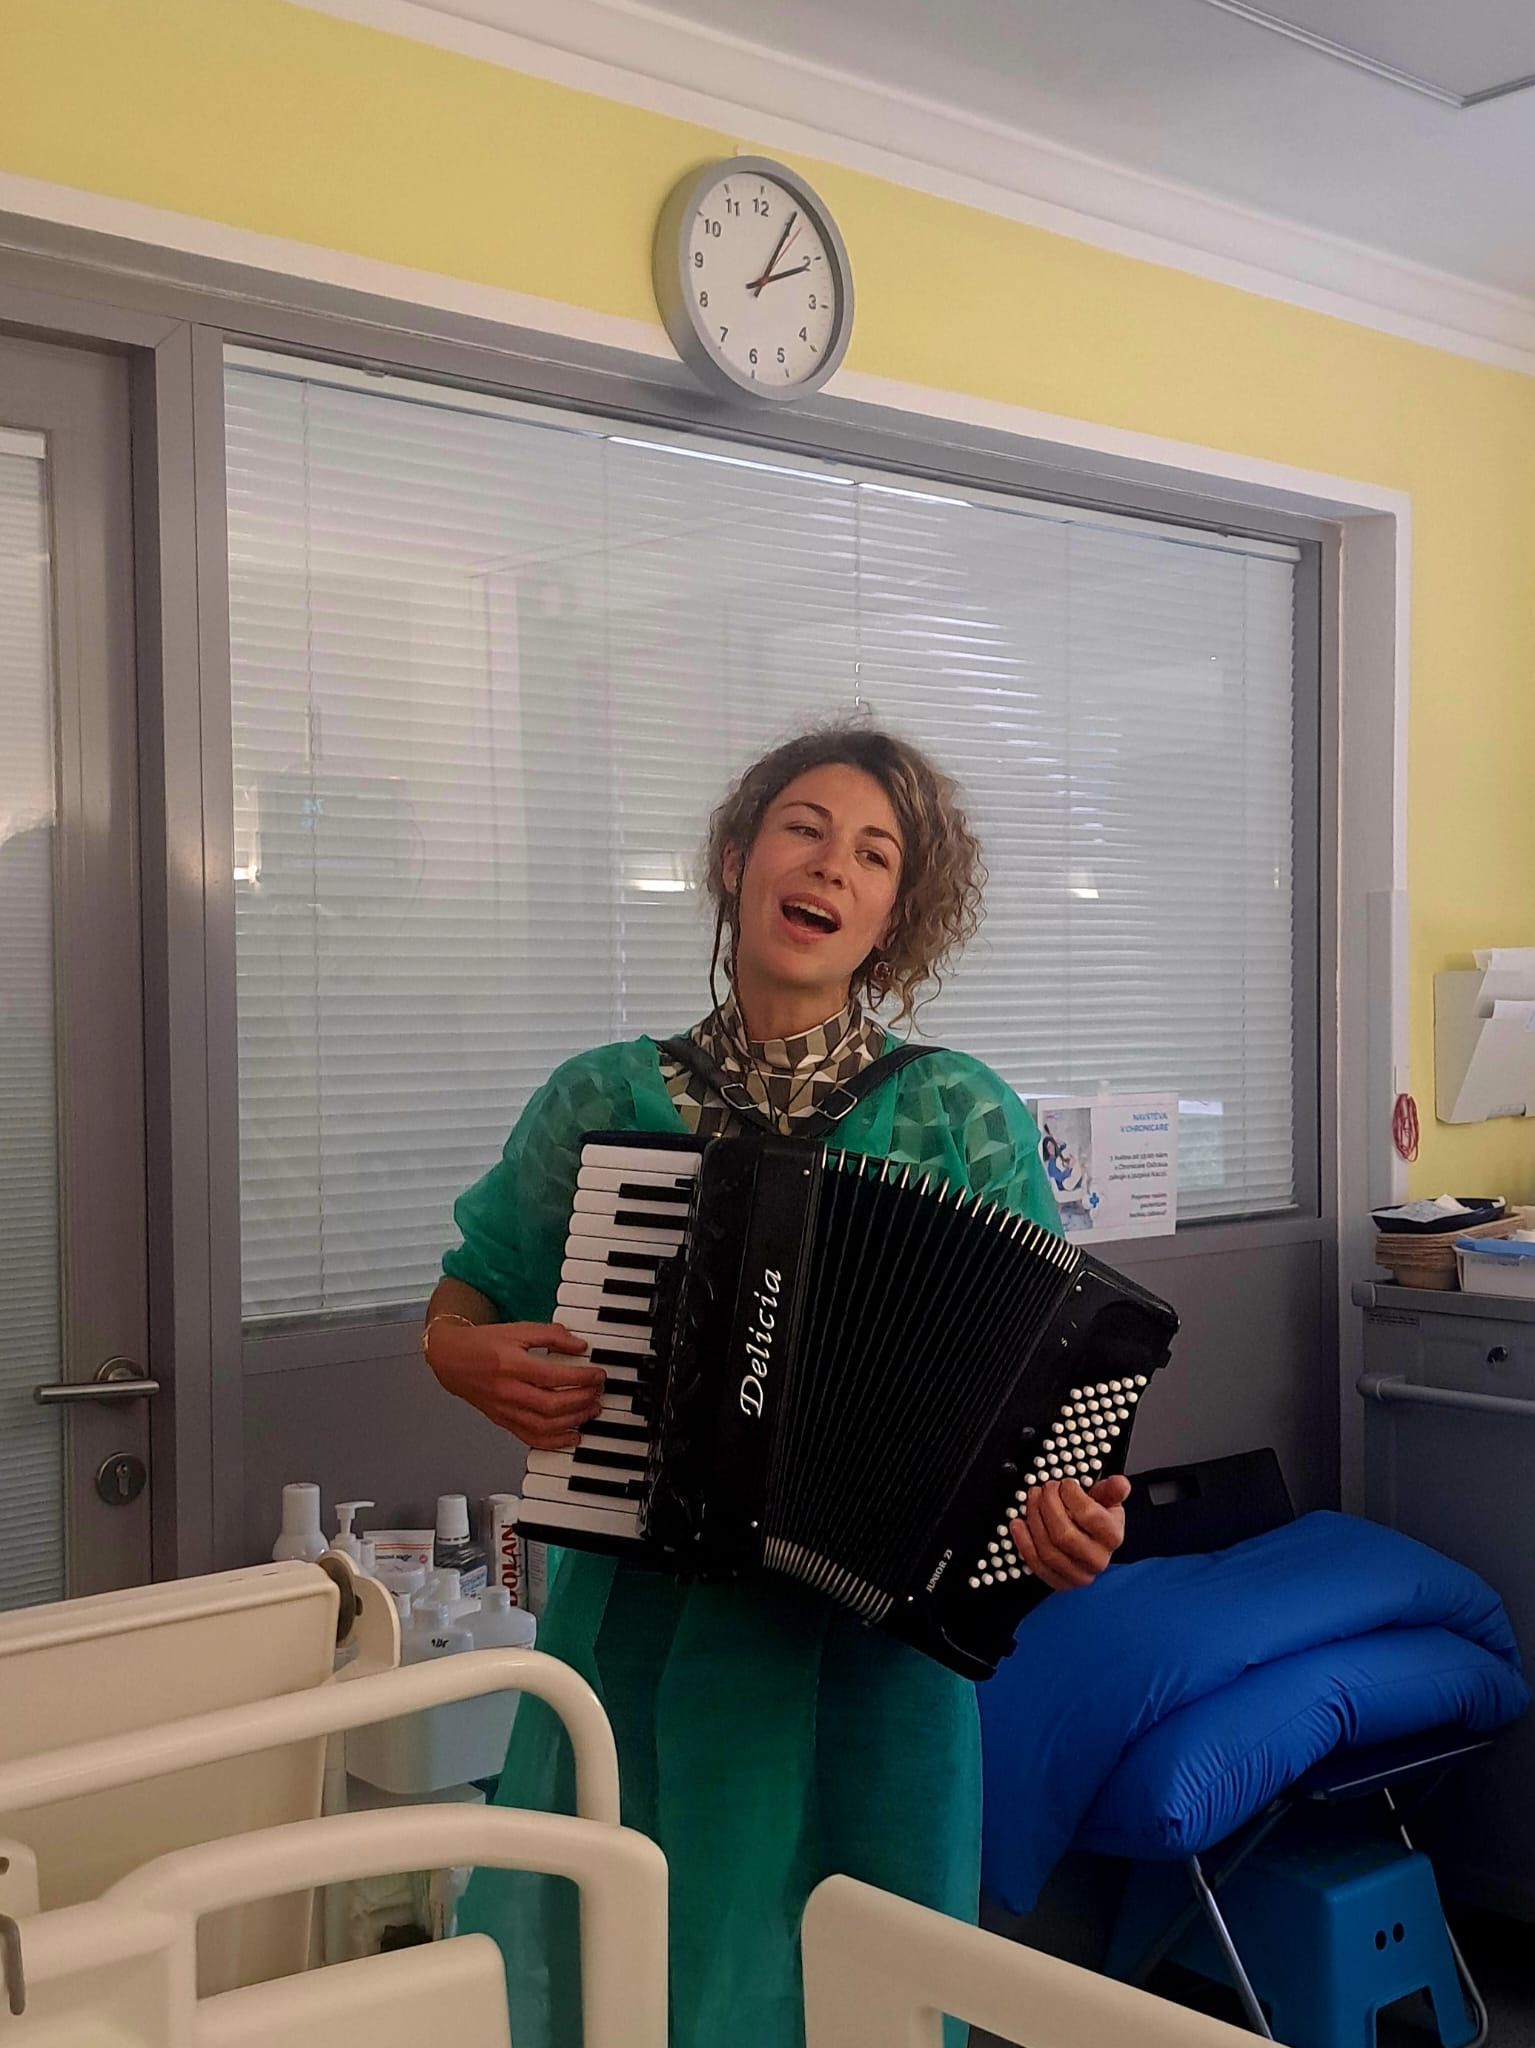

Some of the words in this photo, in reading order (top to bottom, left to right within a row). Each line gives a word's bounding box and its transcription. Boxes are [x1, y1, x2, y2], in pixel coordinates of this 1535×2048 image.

[725, 198, 741, 217] 11
[752, 198, 770, 217] 12
[704, 219, 722, 238] 10
[694, 251, 704, 268] 9
[802, 255, 811, 272] 2
[699, 291, 709, 308] 8
[808, 294, 817, 310] 3
[719, 326, 729, 343] 7
[798, 327, 808, 341] 4
[749, 348, 758, 364] 6
[776, 347, 785, 363] 5
[739, 1268, 782, 1419] Delicia
[926, 1560, 947, 1593] JUNIOR
